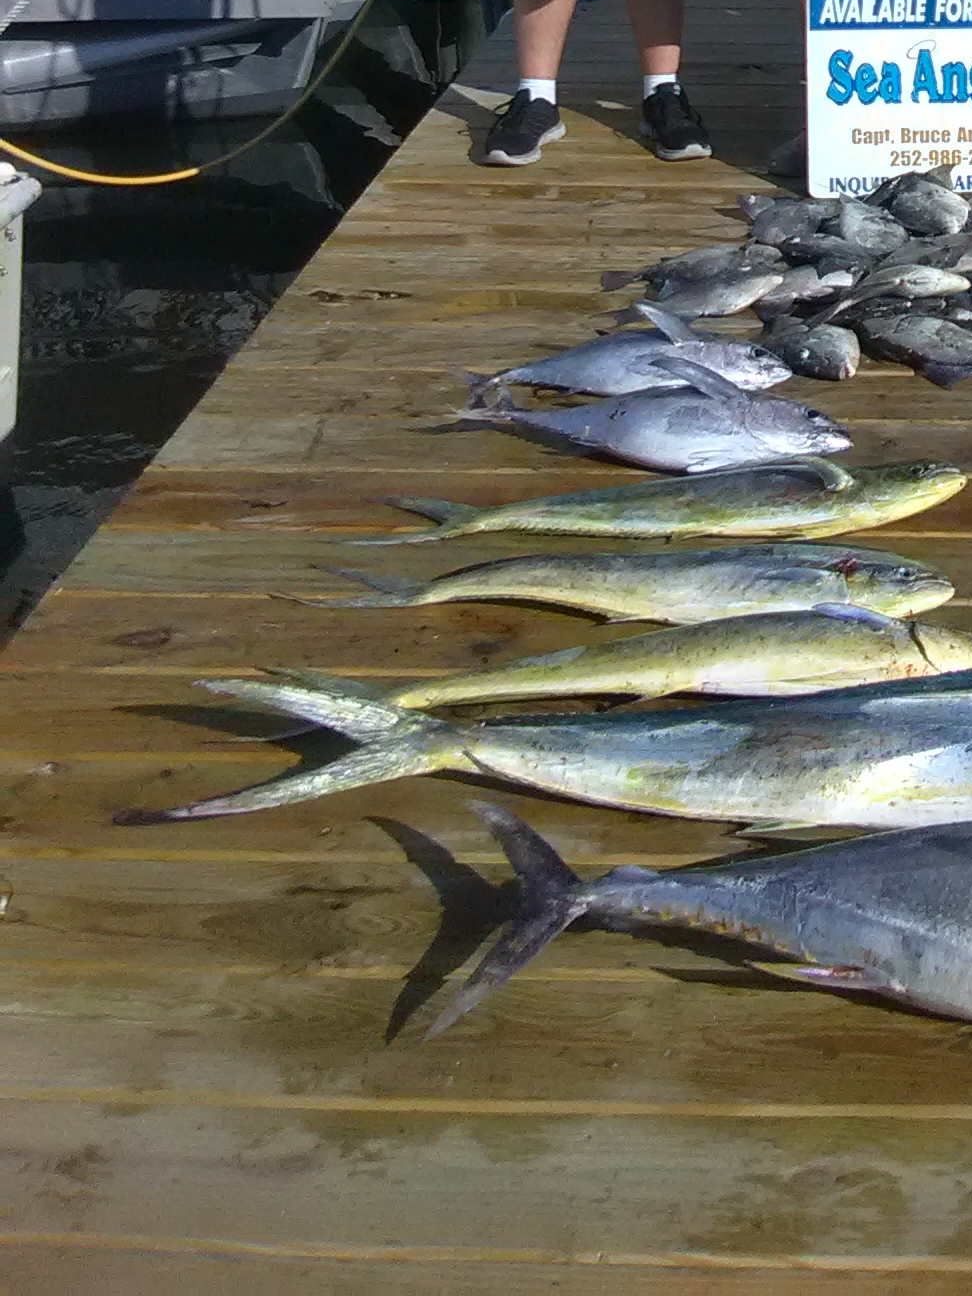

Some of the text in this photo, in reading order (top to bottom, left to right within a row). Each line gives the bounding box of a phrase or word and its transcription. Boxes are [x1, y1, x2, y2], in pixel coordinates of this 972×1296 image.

[826, 48, 902, 106] Sea
[851, 128, 895, 146] Capt.
[900, 127, 951, 144] Bruce
